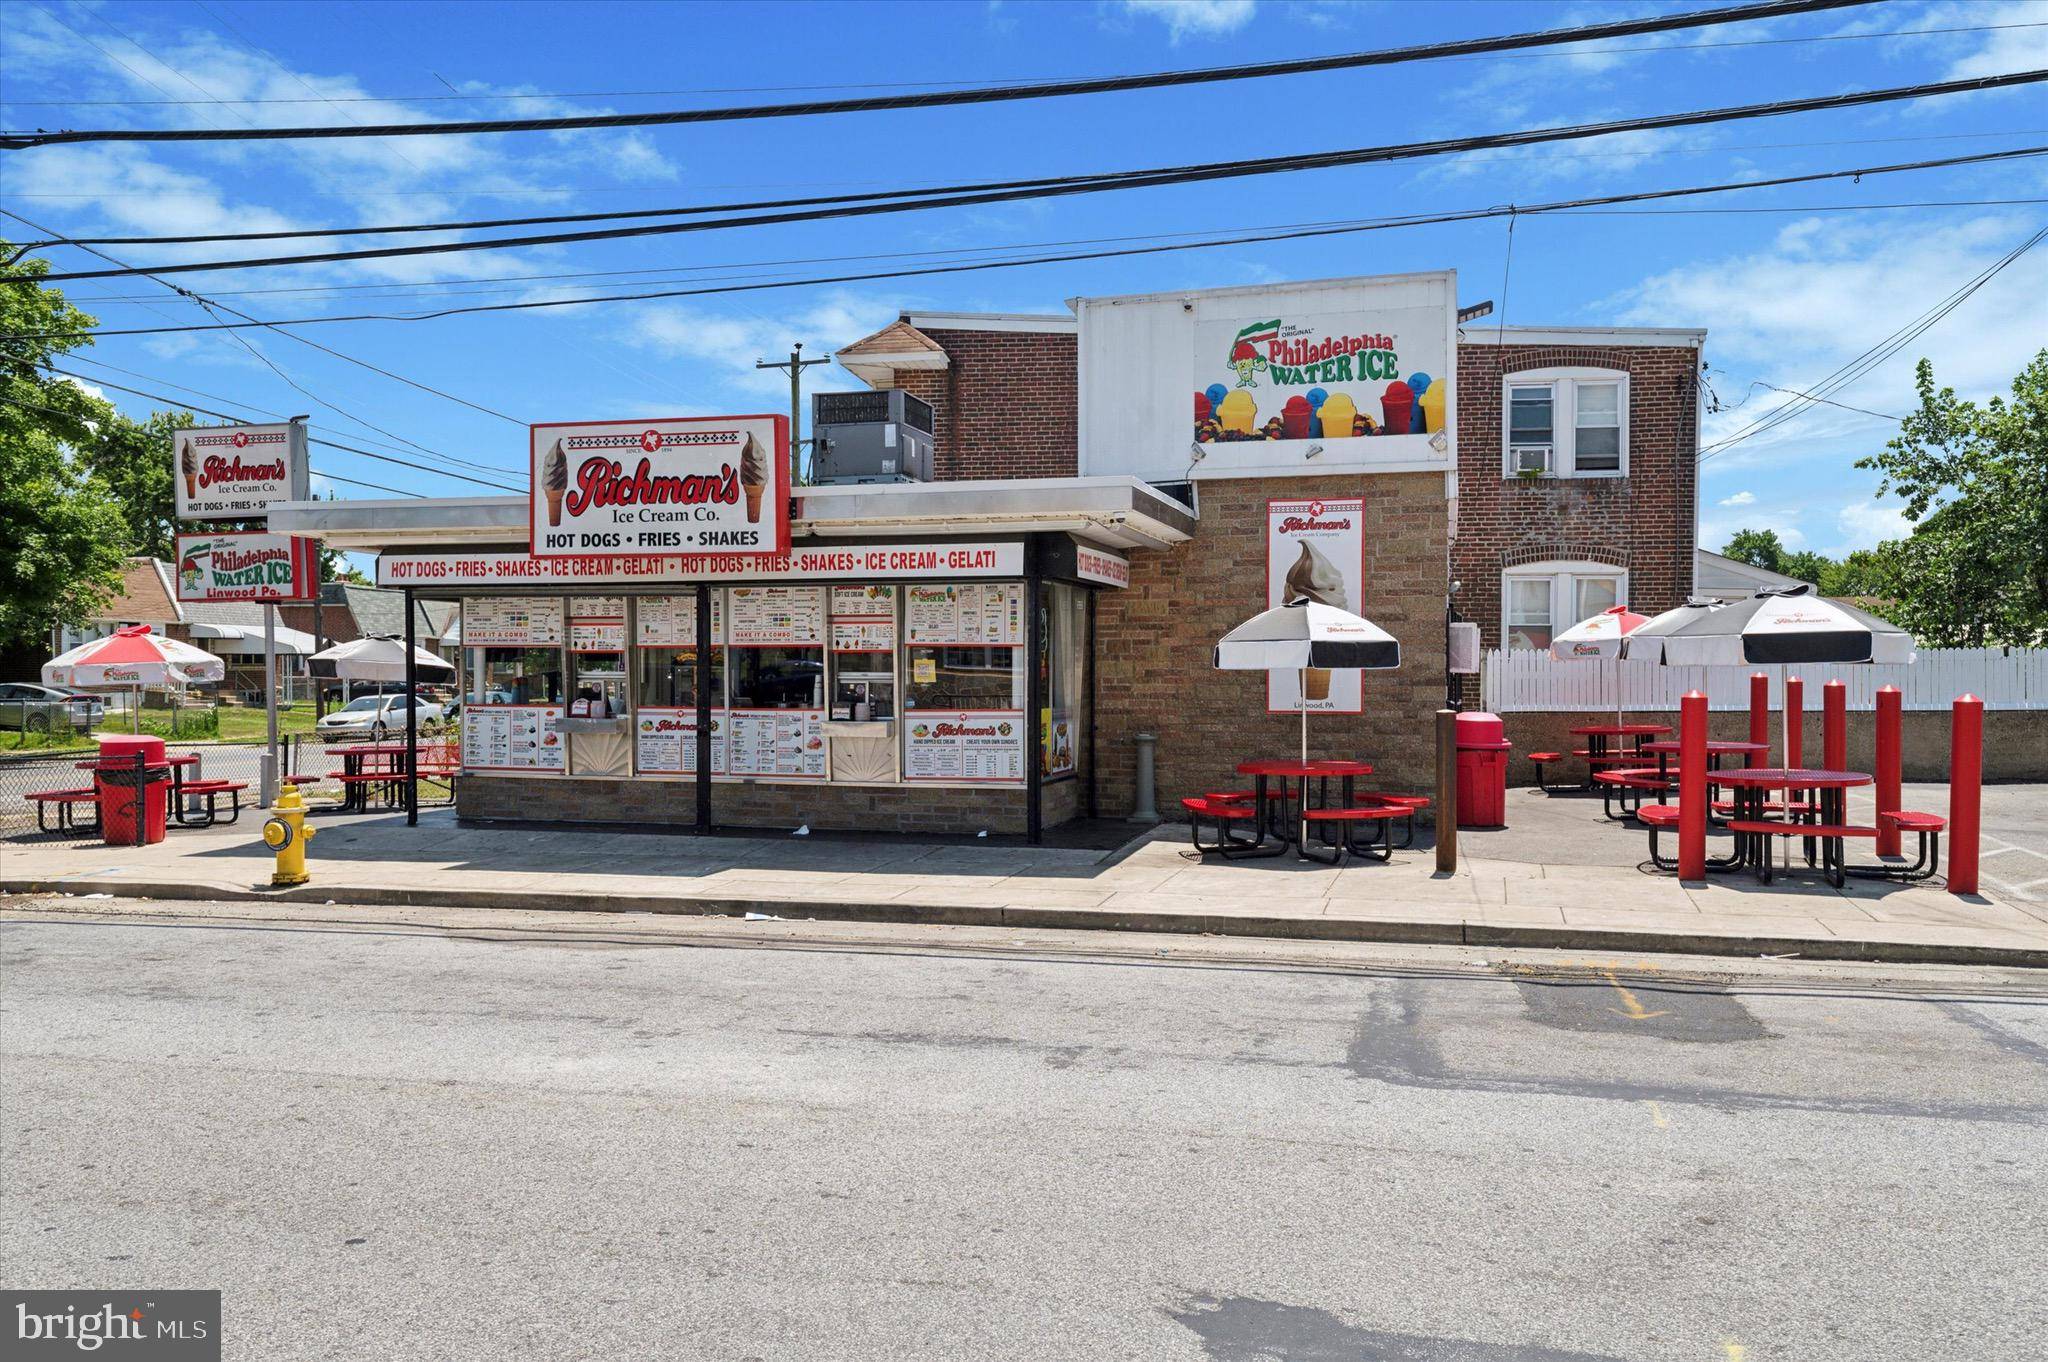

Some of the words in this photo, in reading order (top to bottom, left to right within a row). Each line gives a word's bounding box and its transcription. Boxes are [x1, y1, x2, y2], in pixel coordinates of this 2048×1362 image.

[1267, 333, 1394, 367] Philadelphia
[1269, 353, 1354, 386] WATER
[1357, 349, 1399, 381] ICE
[199, 454, 286, 489] Richman's
[218, 484, 230, 494] Ice
[232, 483, 260, 493] Cream
[262, 482, 277, 492] Co.
[566, 456, 740, 517] Richman's
[188, 503, 202, 512] HOT
[204, 502, 223, 511] DOGS
[231, 501, 251, 510] FRIES
[613, 509, 634, 524] Ice
[638, 507, 689, 523] Cream
[694, 507, 720, 521] Co.
[1279, 516, 1351, 534] Richman's
[546, 533, 576, 548] HOT
[581, 533, 621, 548] DOGS
[638, 532, 681, 547] FRIES
[699, 531, 759, 546] SHAKES
[211, 548, 290, 572] Philadelphia
[391, 562, 413, 578] HOT
[416, 561, 447, 577] DOGS
[455, 560, 487, 577] FRIES
[496, 559, 541, 576] SHAKES
[551, 558, 569, 576] ICE
[572, 558, 614, 576] CREAM
[623, 558, 664, 576] GELATI
[681, 557, 706, 574] HOT
[710, 556, 744, 573] DOGS
[754, 555, 790, 572] FRIES
[801, 554, 854, 571] SHAKES
[865, 553, 886, 570] ICE
[890, 552, 937, 570] CREAM
[948, 551, 996, 569] GELATI
[212, 564, 266, 587] WATER
[267, 561, 293, 584] ICE
[206, 586, 256, 598] Linwood
[932, 723, 996, 738] Richman's
